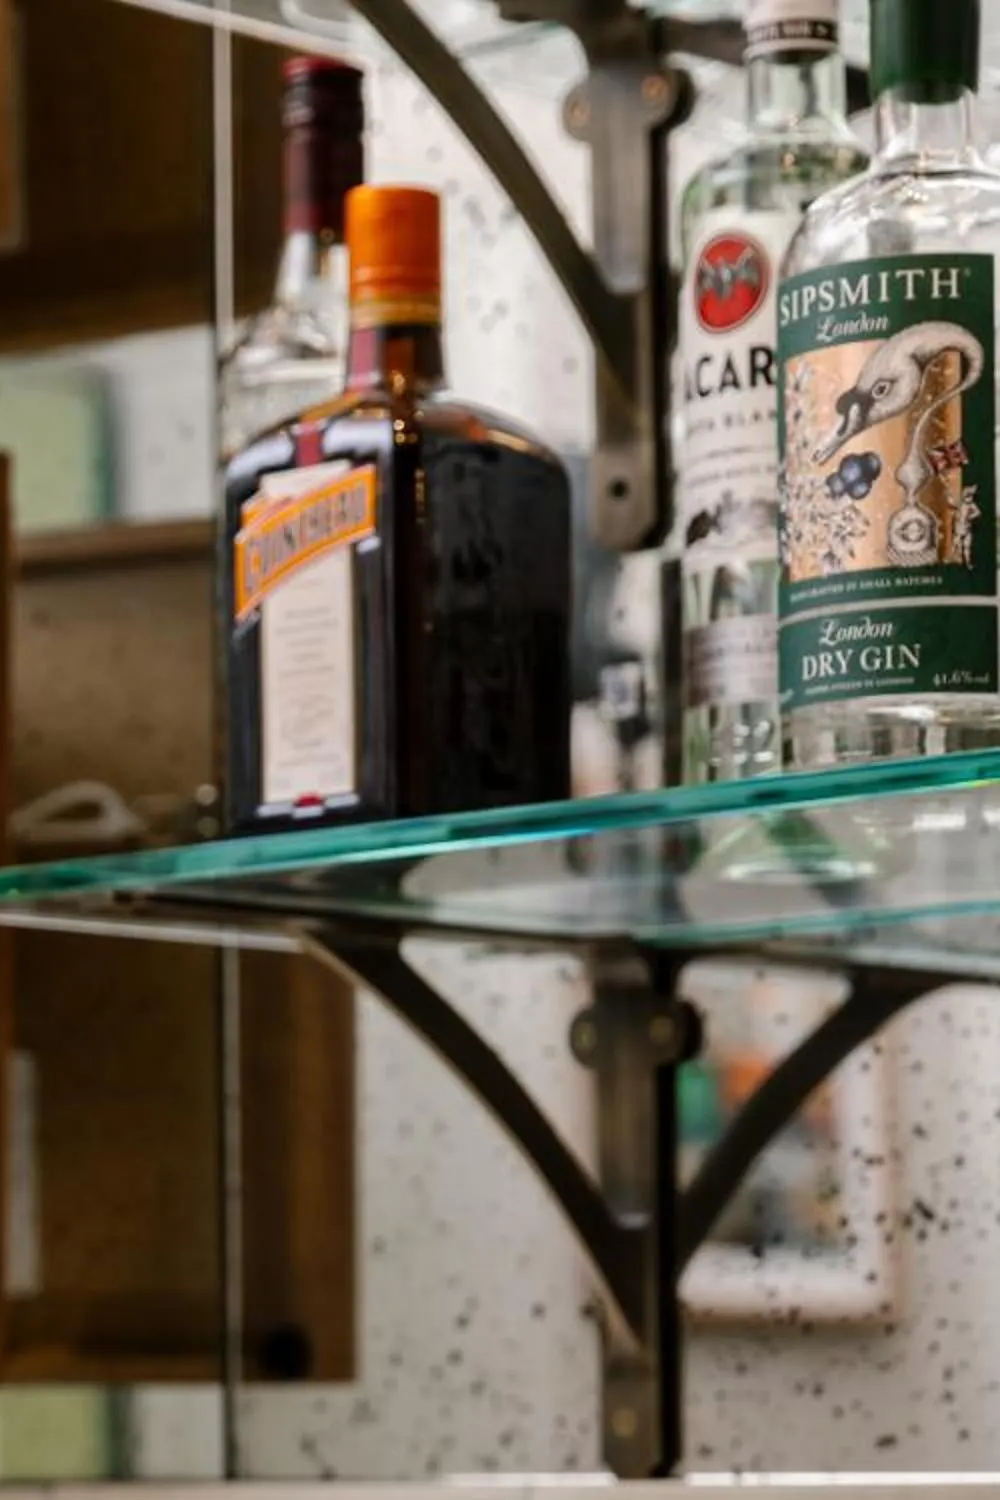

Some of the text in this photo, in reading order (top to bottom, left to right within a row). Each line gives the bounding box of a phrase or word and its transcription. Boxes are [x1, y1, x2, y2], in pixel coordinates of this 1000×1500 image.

[779, 267, 961, 327] SIPSMITH
[816, 311, 889, 342] London
[818, 616, 893, 646] London
[802, 643, 921, 681] DRY GIN
